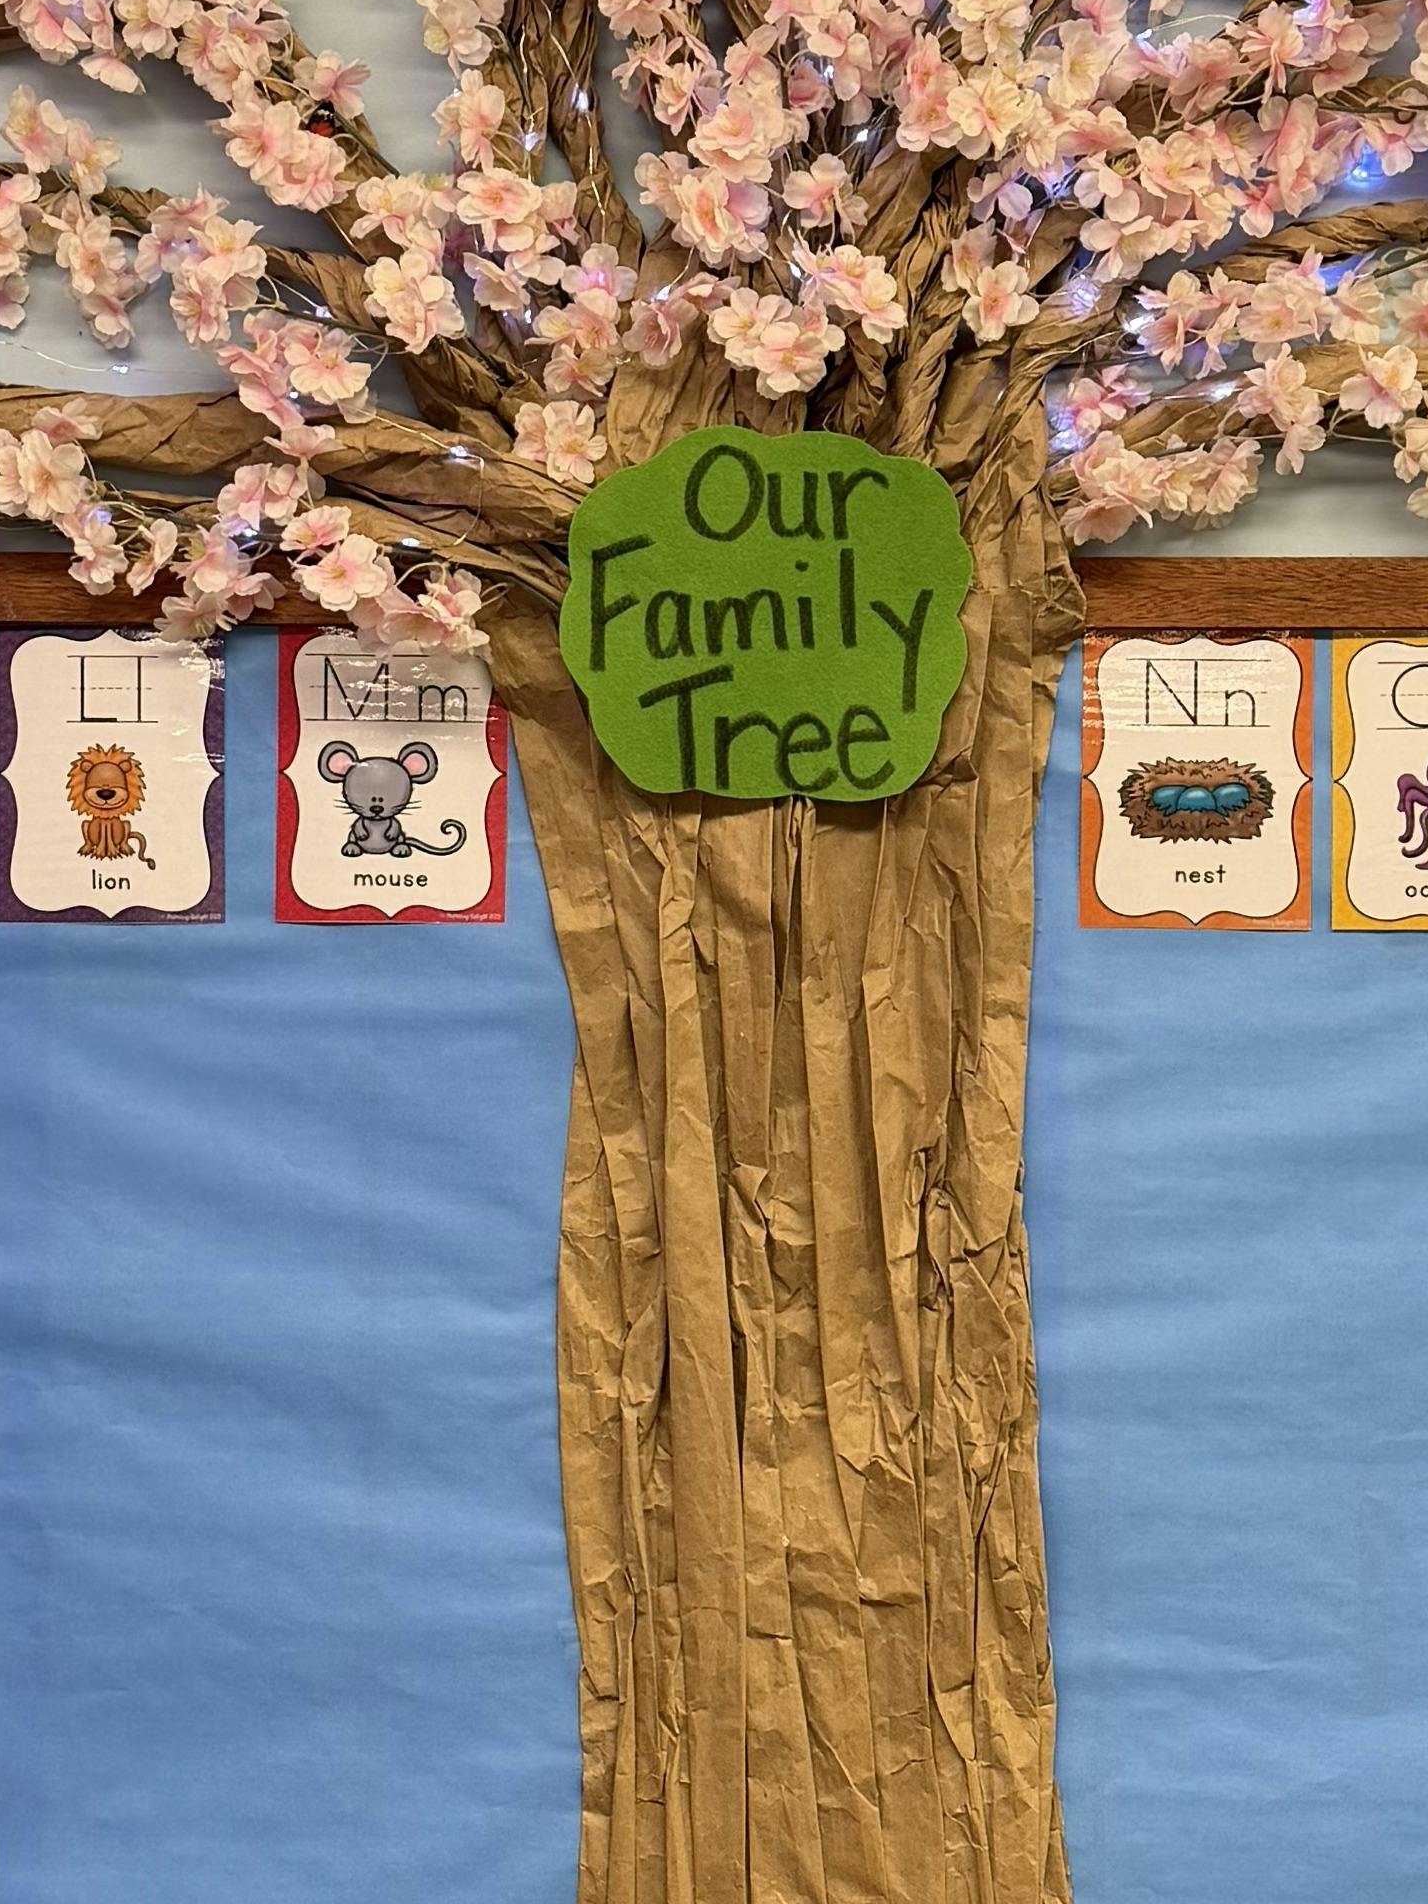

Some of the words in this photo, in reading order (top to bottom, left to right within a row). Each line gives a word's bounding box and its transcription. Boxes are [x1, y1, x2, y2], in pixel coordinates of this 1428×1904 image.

[684, 444, 889, 542] Our
[589, 534, 934, 714] Family
[324, 656, 467, 723] Mm
[1146, 659, 1258, 727] Nn
[638, 665, 894, 793] Tree
[90, 867, 132, 891] lion
[352, 872, 429, 889] mouse
[1174, 863, 1227, 885] nest
